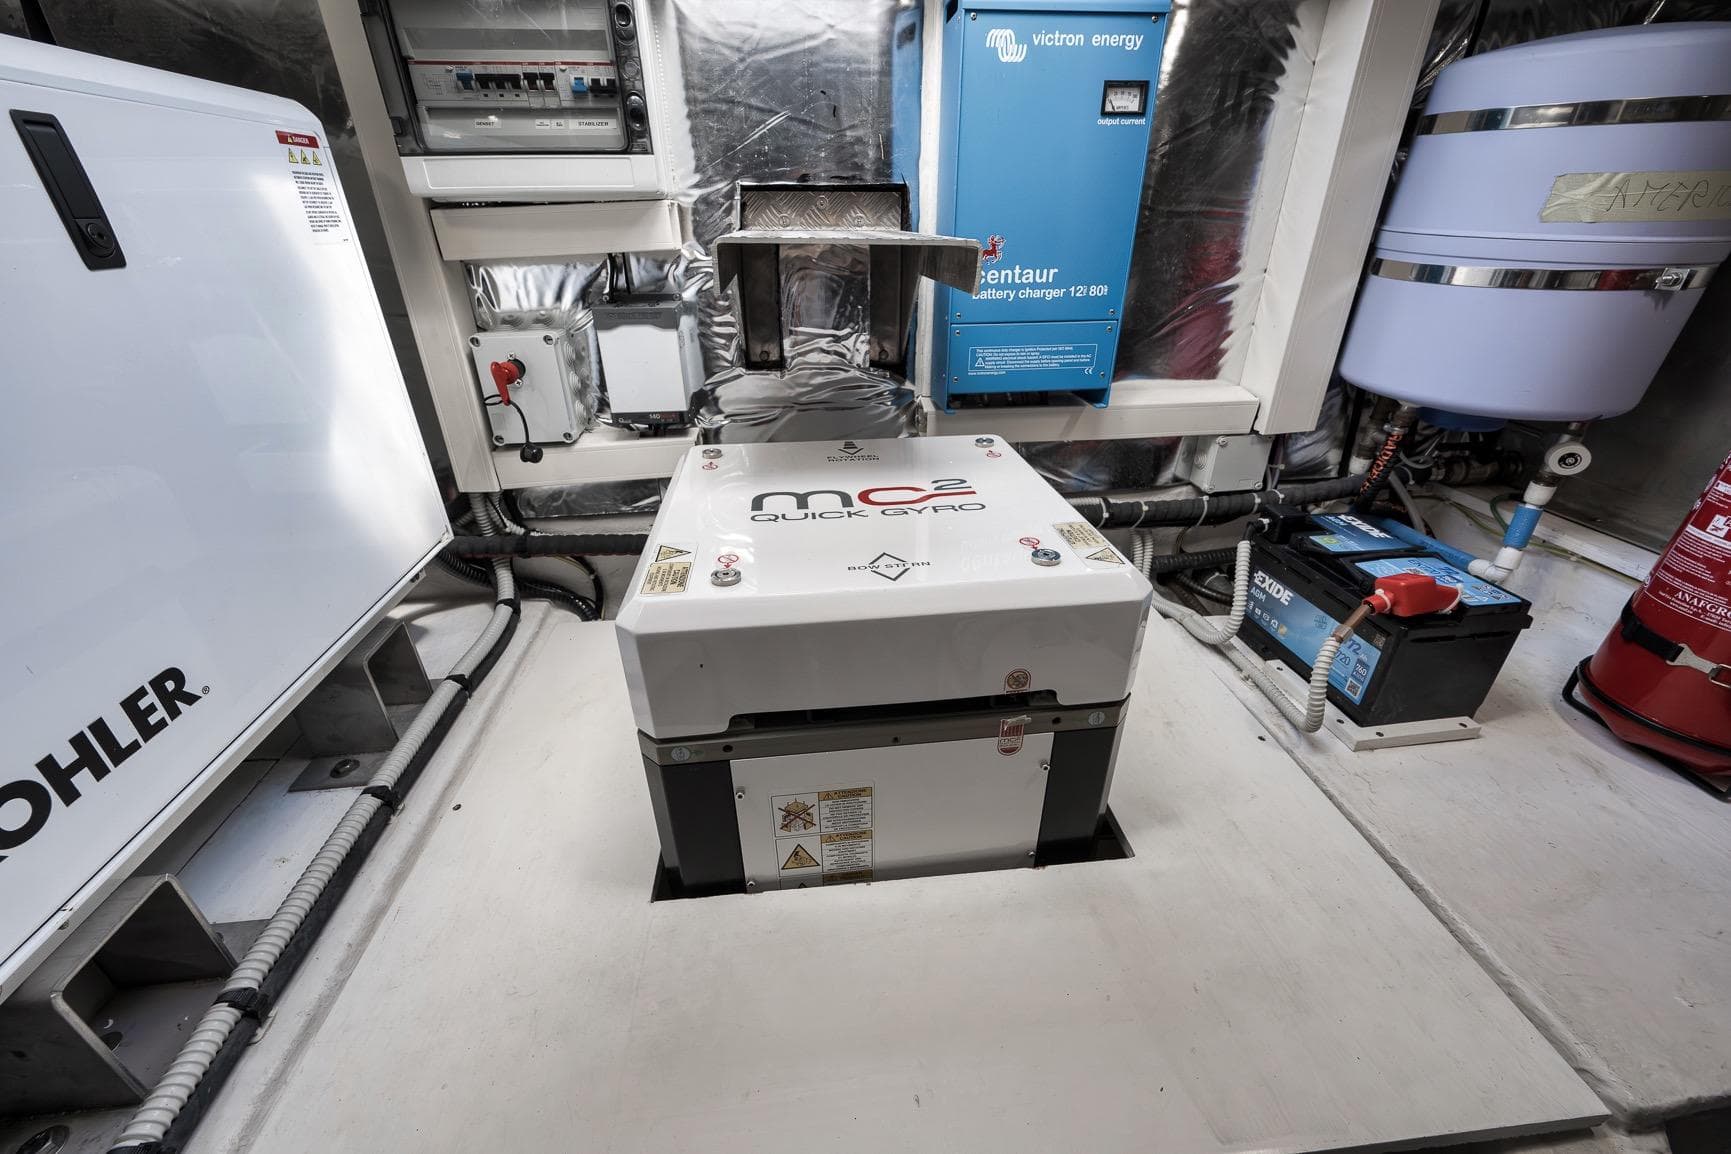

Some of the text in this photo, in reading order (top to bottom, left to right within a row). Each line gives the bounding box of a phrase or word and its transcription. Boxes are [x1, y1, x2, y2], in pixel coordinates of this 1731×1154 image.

[1032, 30, 1144, 50] victron energy
[1097, 117, 1146, 126] output current
[1018, 286, 1066, 300] charger
[750, 502, 986, 522] QUICK GYRO
[1250, 587, 1267, 603] AGM
[1253, 570, 1294, 606] EXIDE
[0, 667, 203, 863] OHLER
